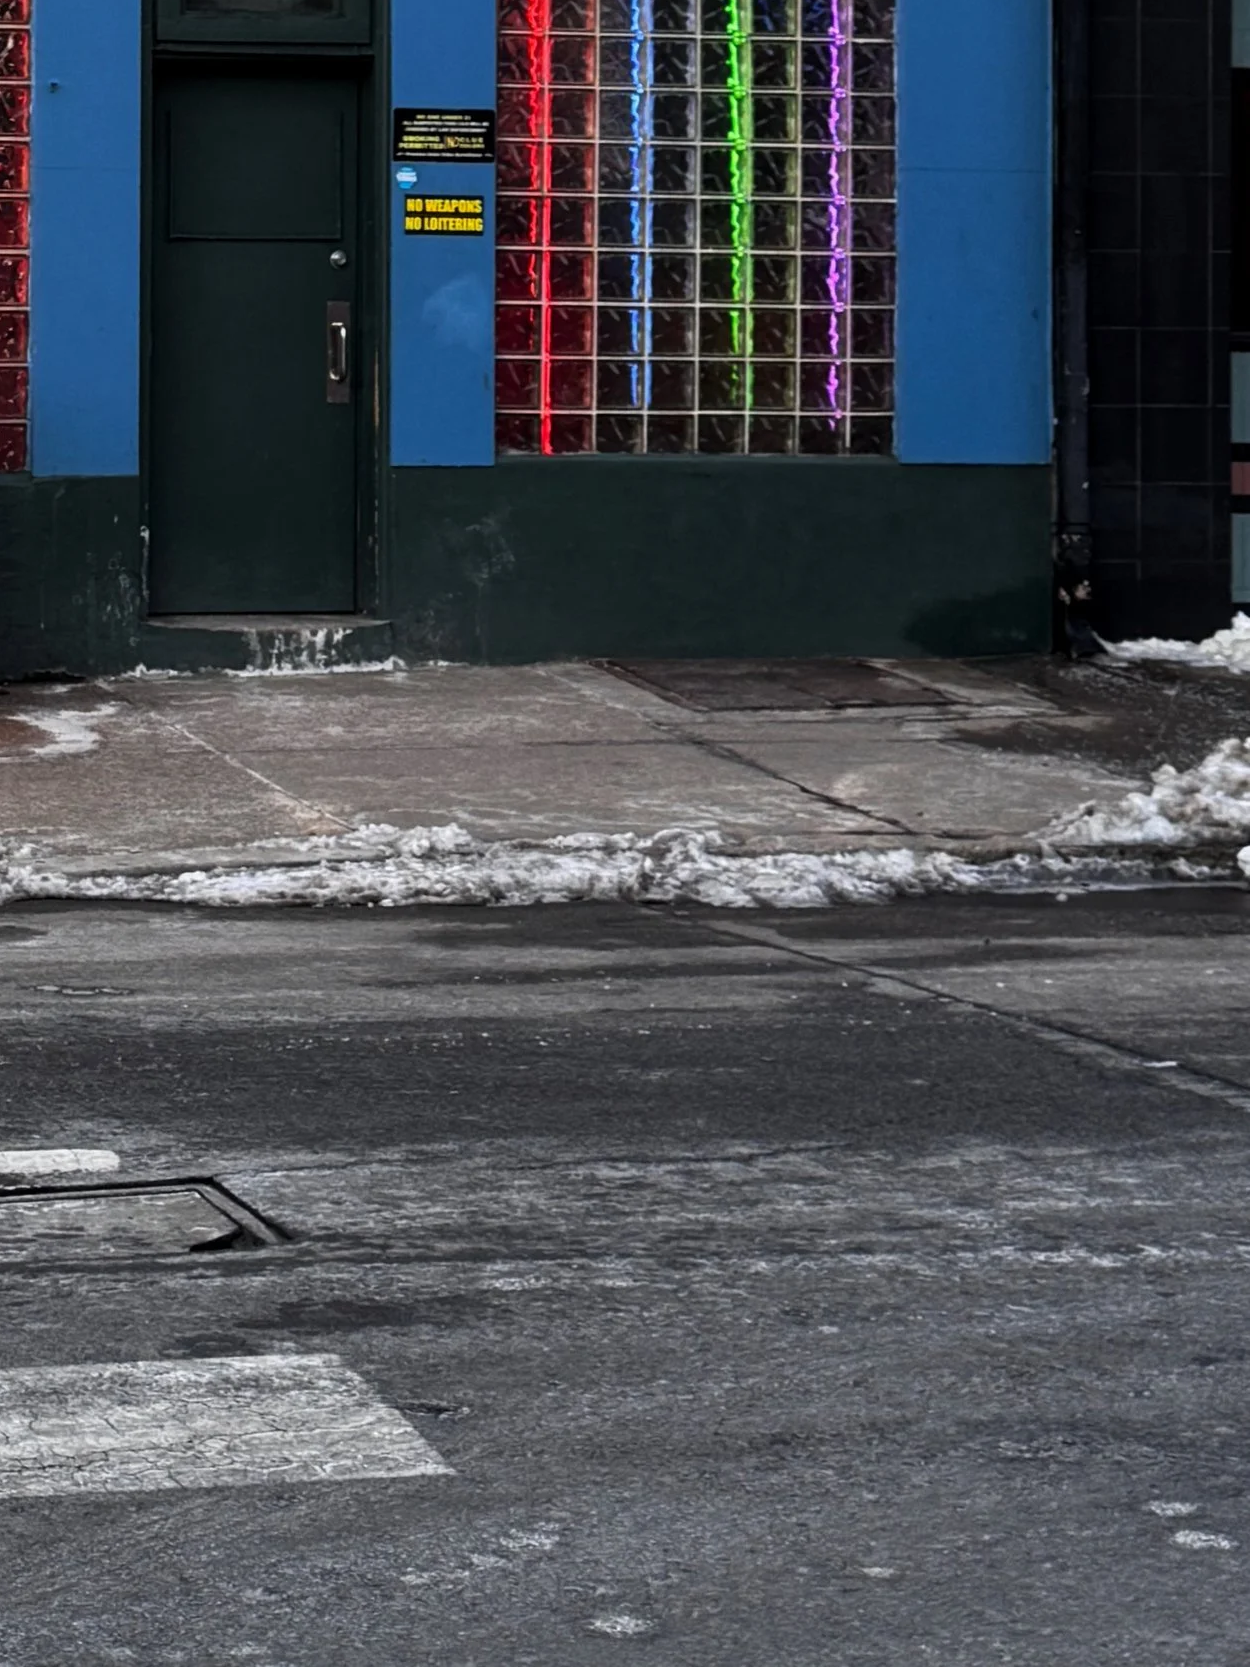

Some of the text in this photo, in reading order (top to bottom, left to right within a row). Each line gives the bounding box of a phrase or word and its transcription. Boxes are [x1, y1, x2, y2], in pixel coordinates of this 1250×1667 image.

[406, 198, 483, 213] NO WEAPONS
[405, 217, 483, 231] NO LOITERING
